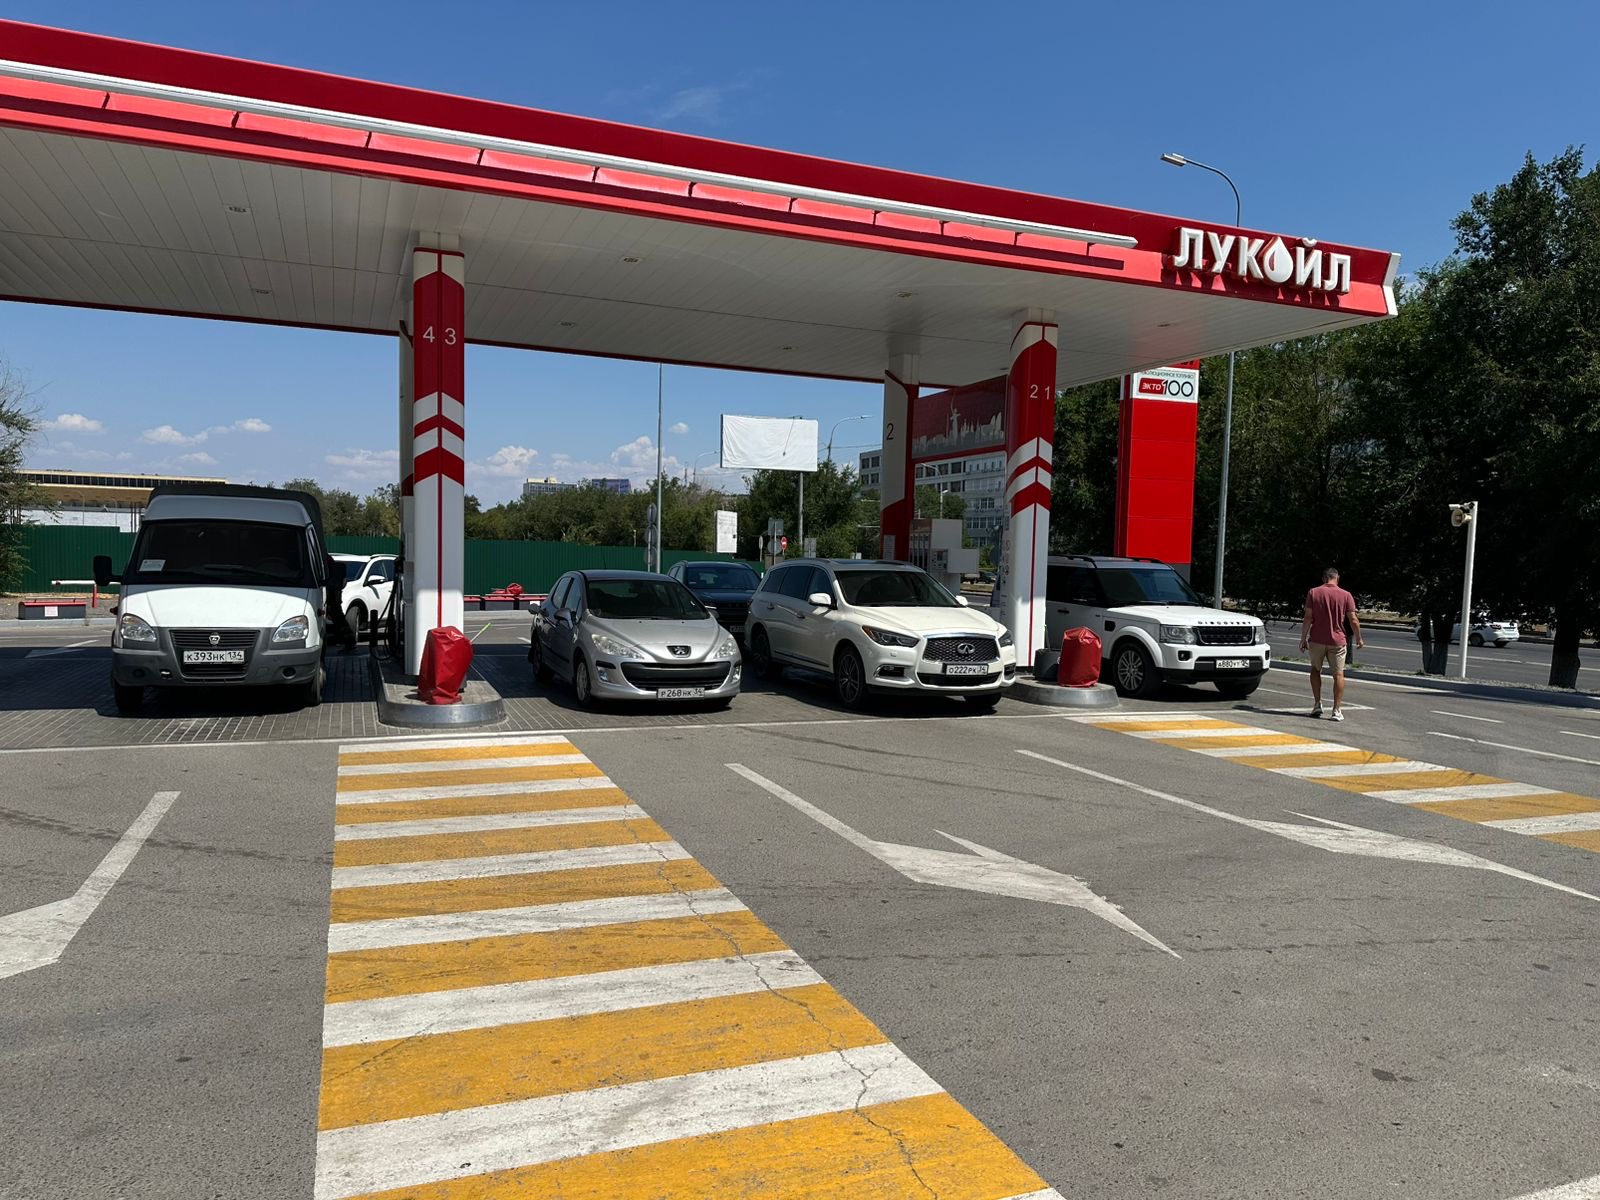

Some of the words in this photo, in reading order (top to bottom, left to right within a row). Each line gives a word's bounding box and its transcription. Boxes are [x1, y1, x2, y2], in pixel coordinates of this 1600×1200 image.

[1173, 227, 1351, 293] ЛУКОЙЛ
[422, 326, 436, 343] 4
[444, 327, 456, 345] 3
[1029, 384, 1038, 399] 2
[1045, 386, 1050, 400] 1
[1141, 382, 1162, 391] ЭКТО
[1163, 379, 1194, 397] 100
[886, 423, 894, 440] 2
[186, 652, 225, 661] К393НК
[227, 651, 242, 659] 134
